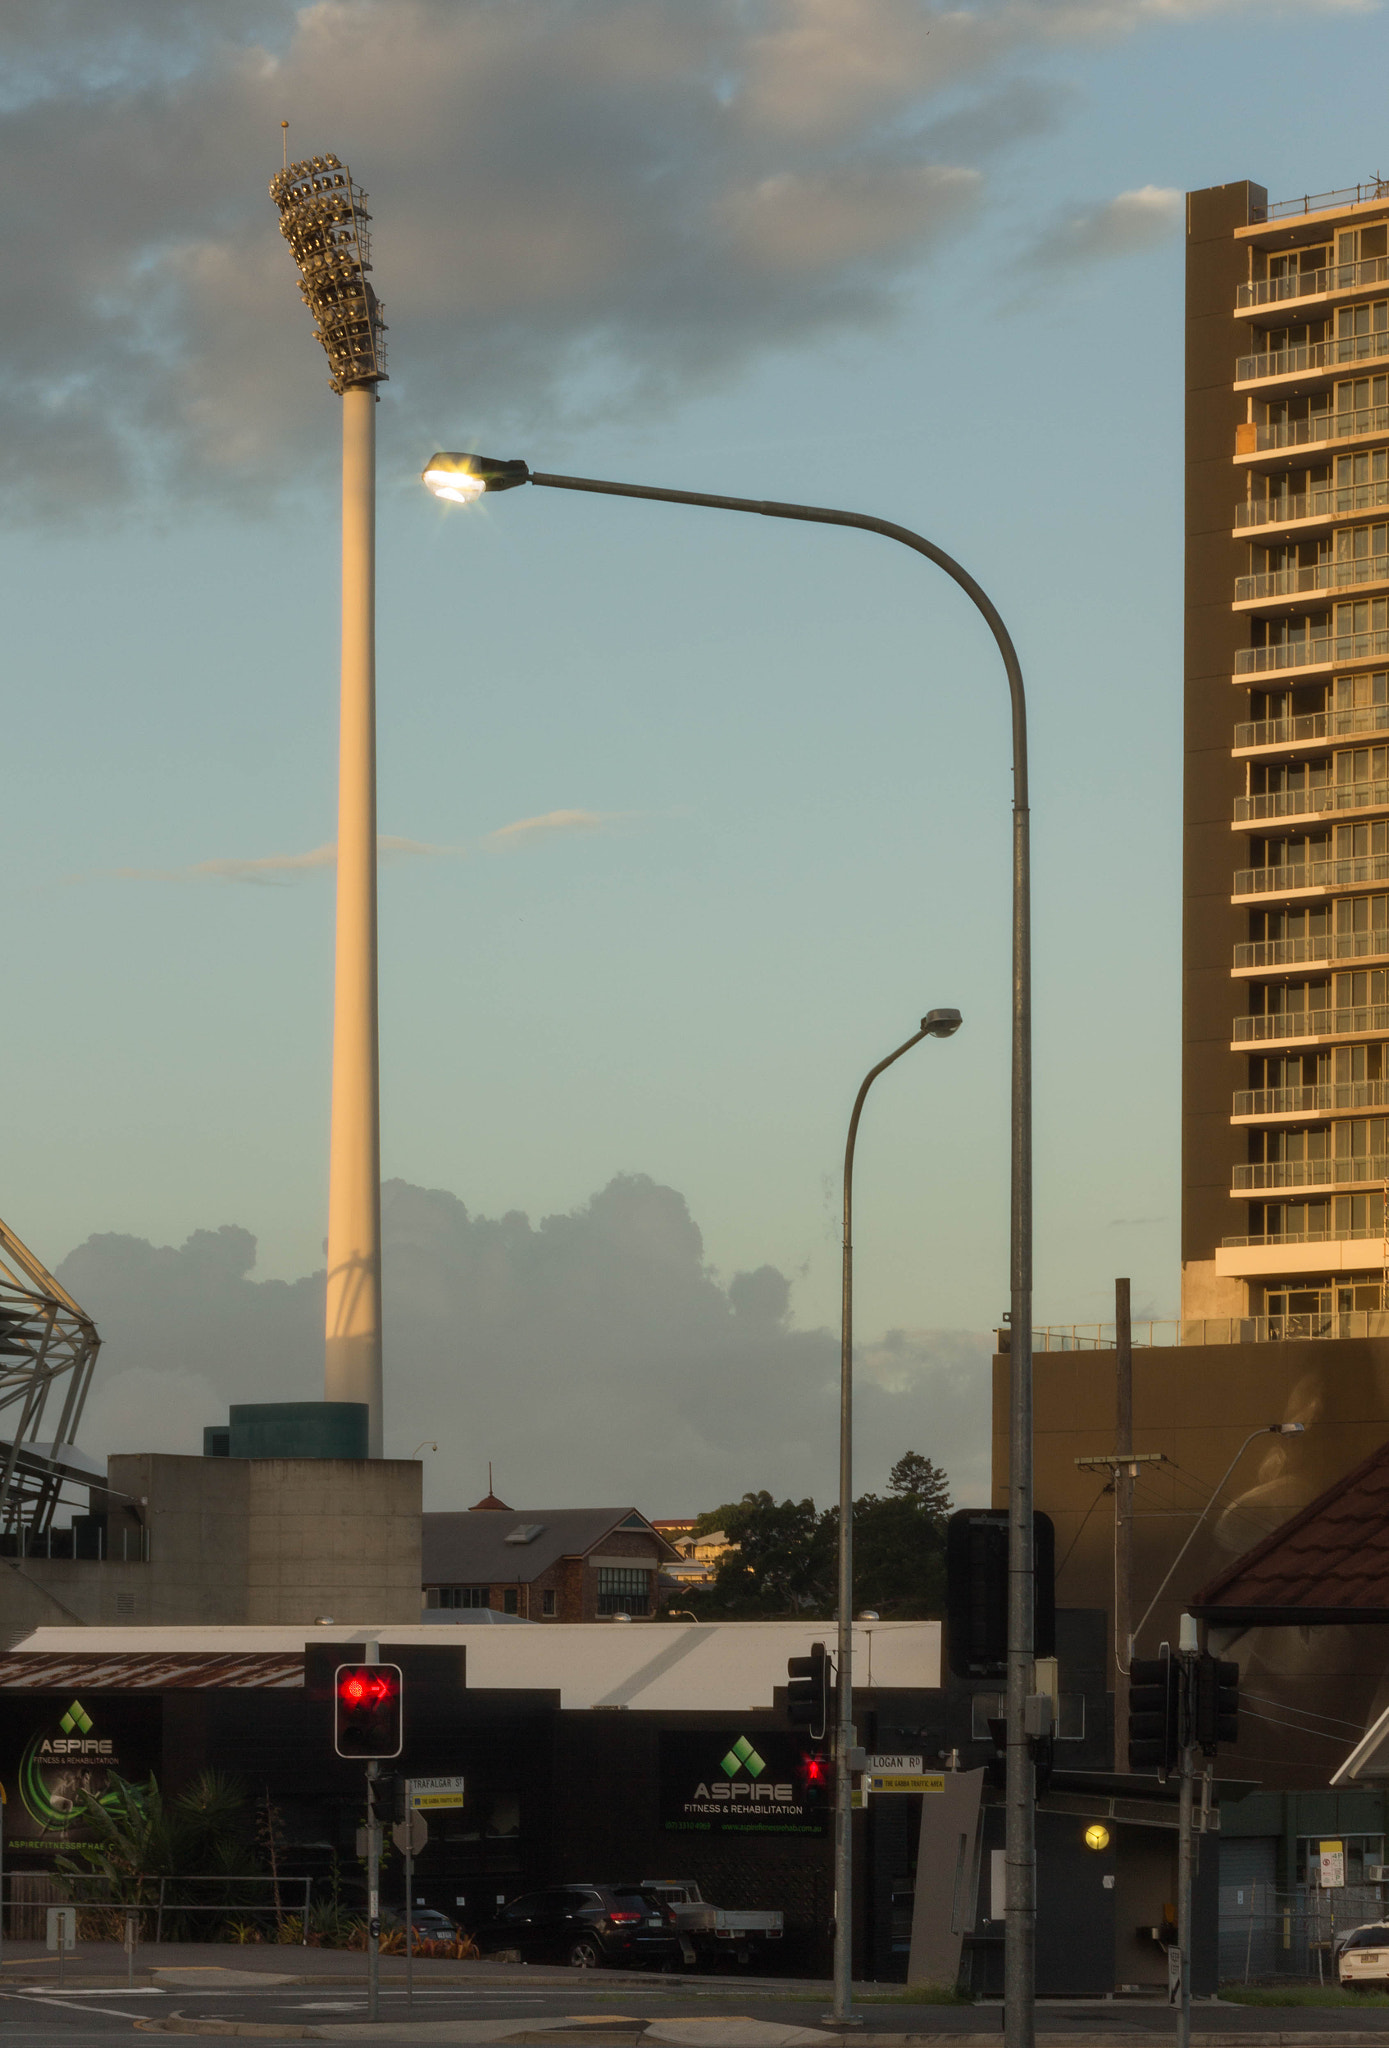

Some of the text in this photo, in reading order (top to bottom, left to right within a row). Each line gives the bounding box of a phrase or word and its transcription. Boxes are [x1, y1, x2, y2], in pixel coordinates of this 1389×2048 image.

[40, 1739, 112, 1754] ASPIRE
[33, 1756, 60, 1764] FITNESS
[67, 1757, 119, 1765] REHABILITATION
[873, 1757, 903, 1768] LOGAN
[413, 1779, 451, 1789] TRAFALGAR
[694, 1782, 792, 1801] ASPIRE
[684, 1804, 803, 1815] FITNESS & REHABILITATION
